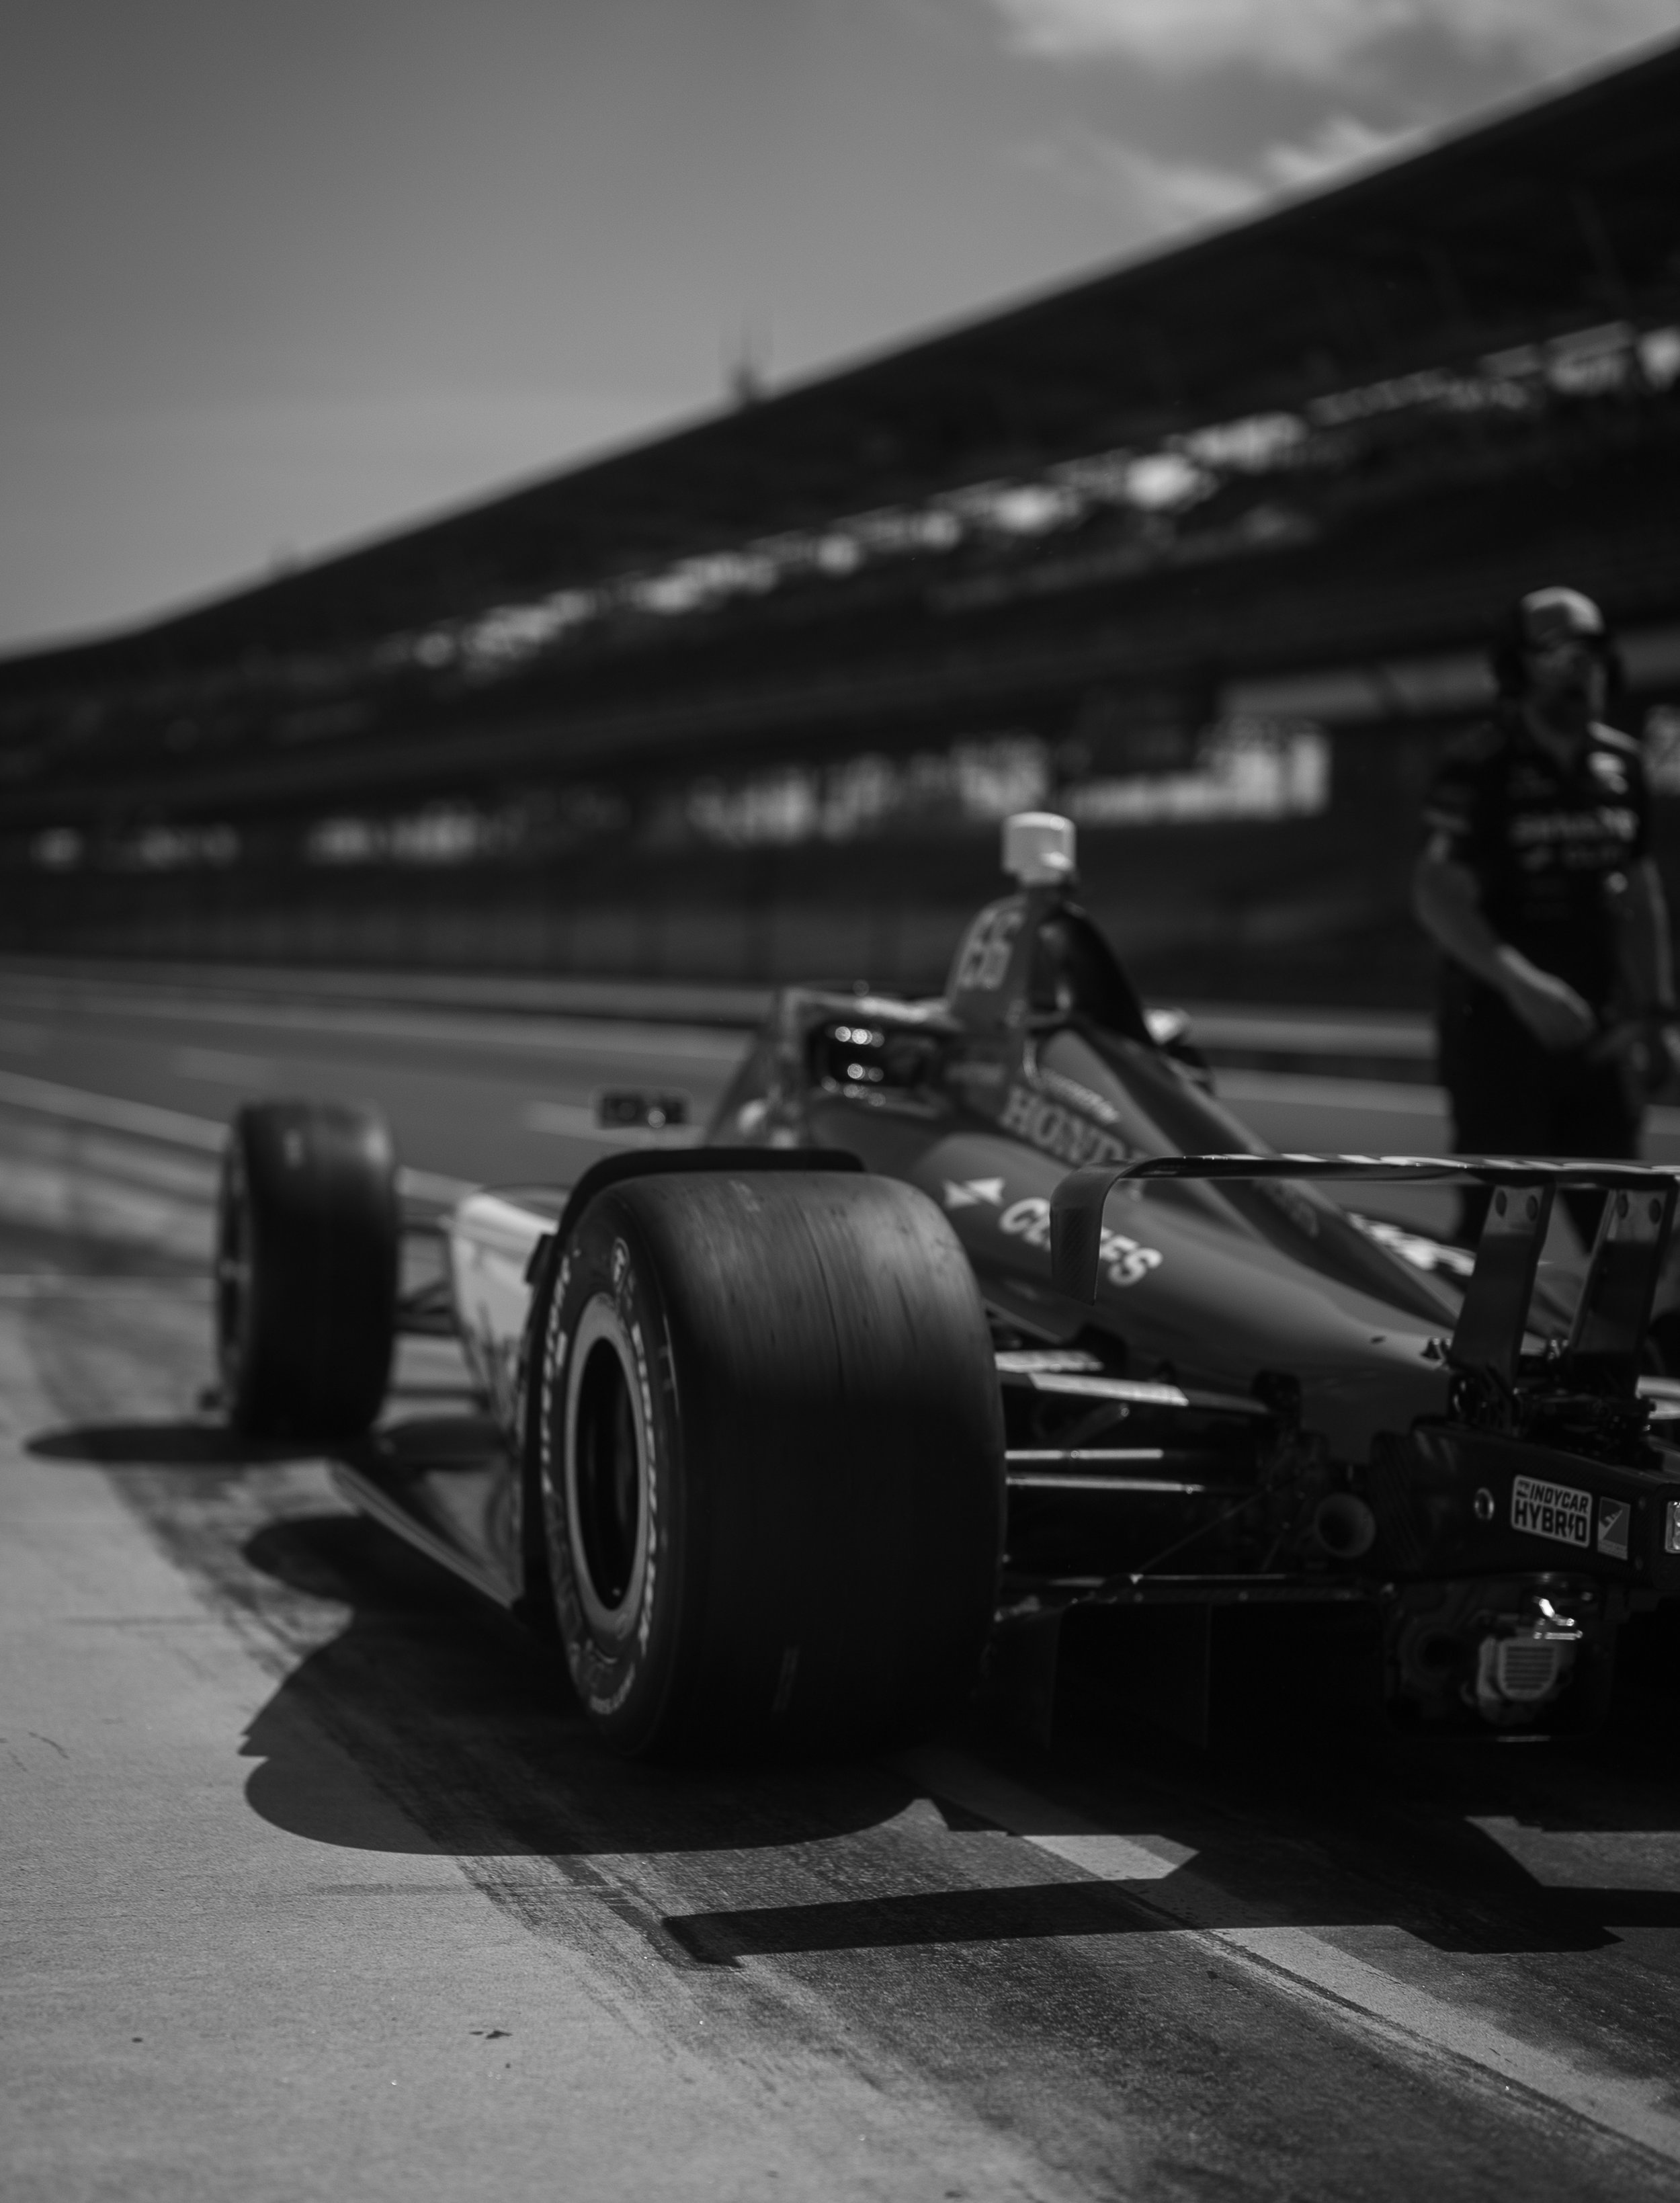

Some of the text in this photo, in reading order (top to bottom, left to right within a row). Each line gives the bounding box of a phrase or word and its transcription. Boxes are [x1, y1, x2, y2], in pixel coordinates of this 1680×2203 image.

[999, 1083, 1136, 1169] HOND
[1530, 1484, 1589, 1513] INDYCAR
[1515, 1499, 1587, 1542] HYBRID
